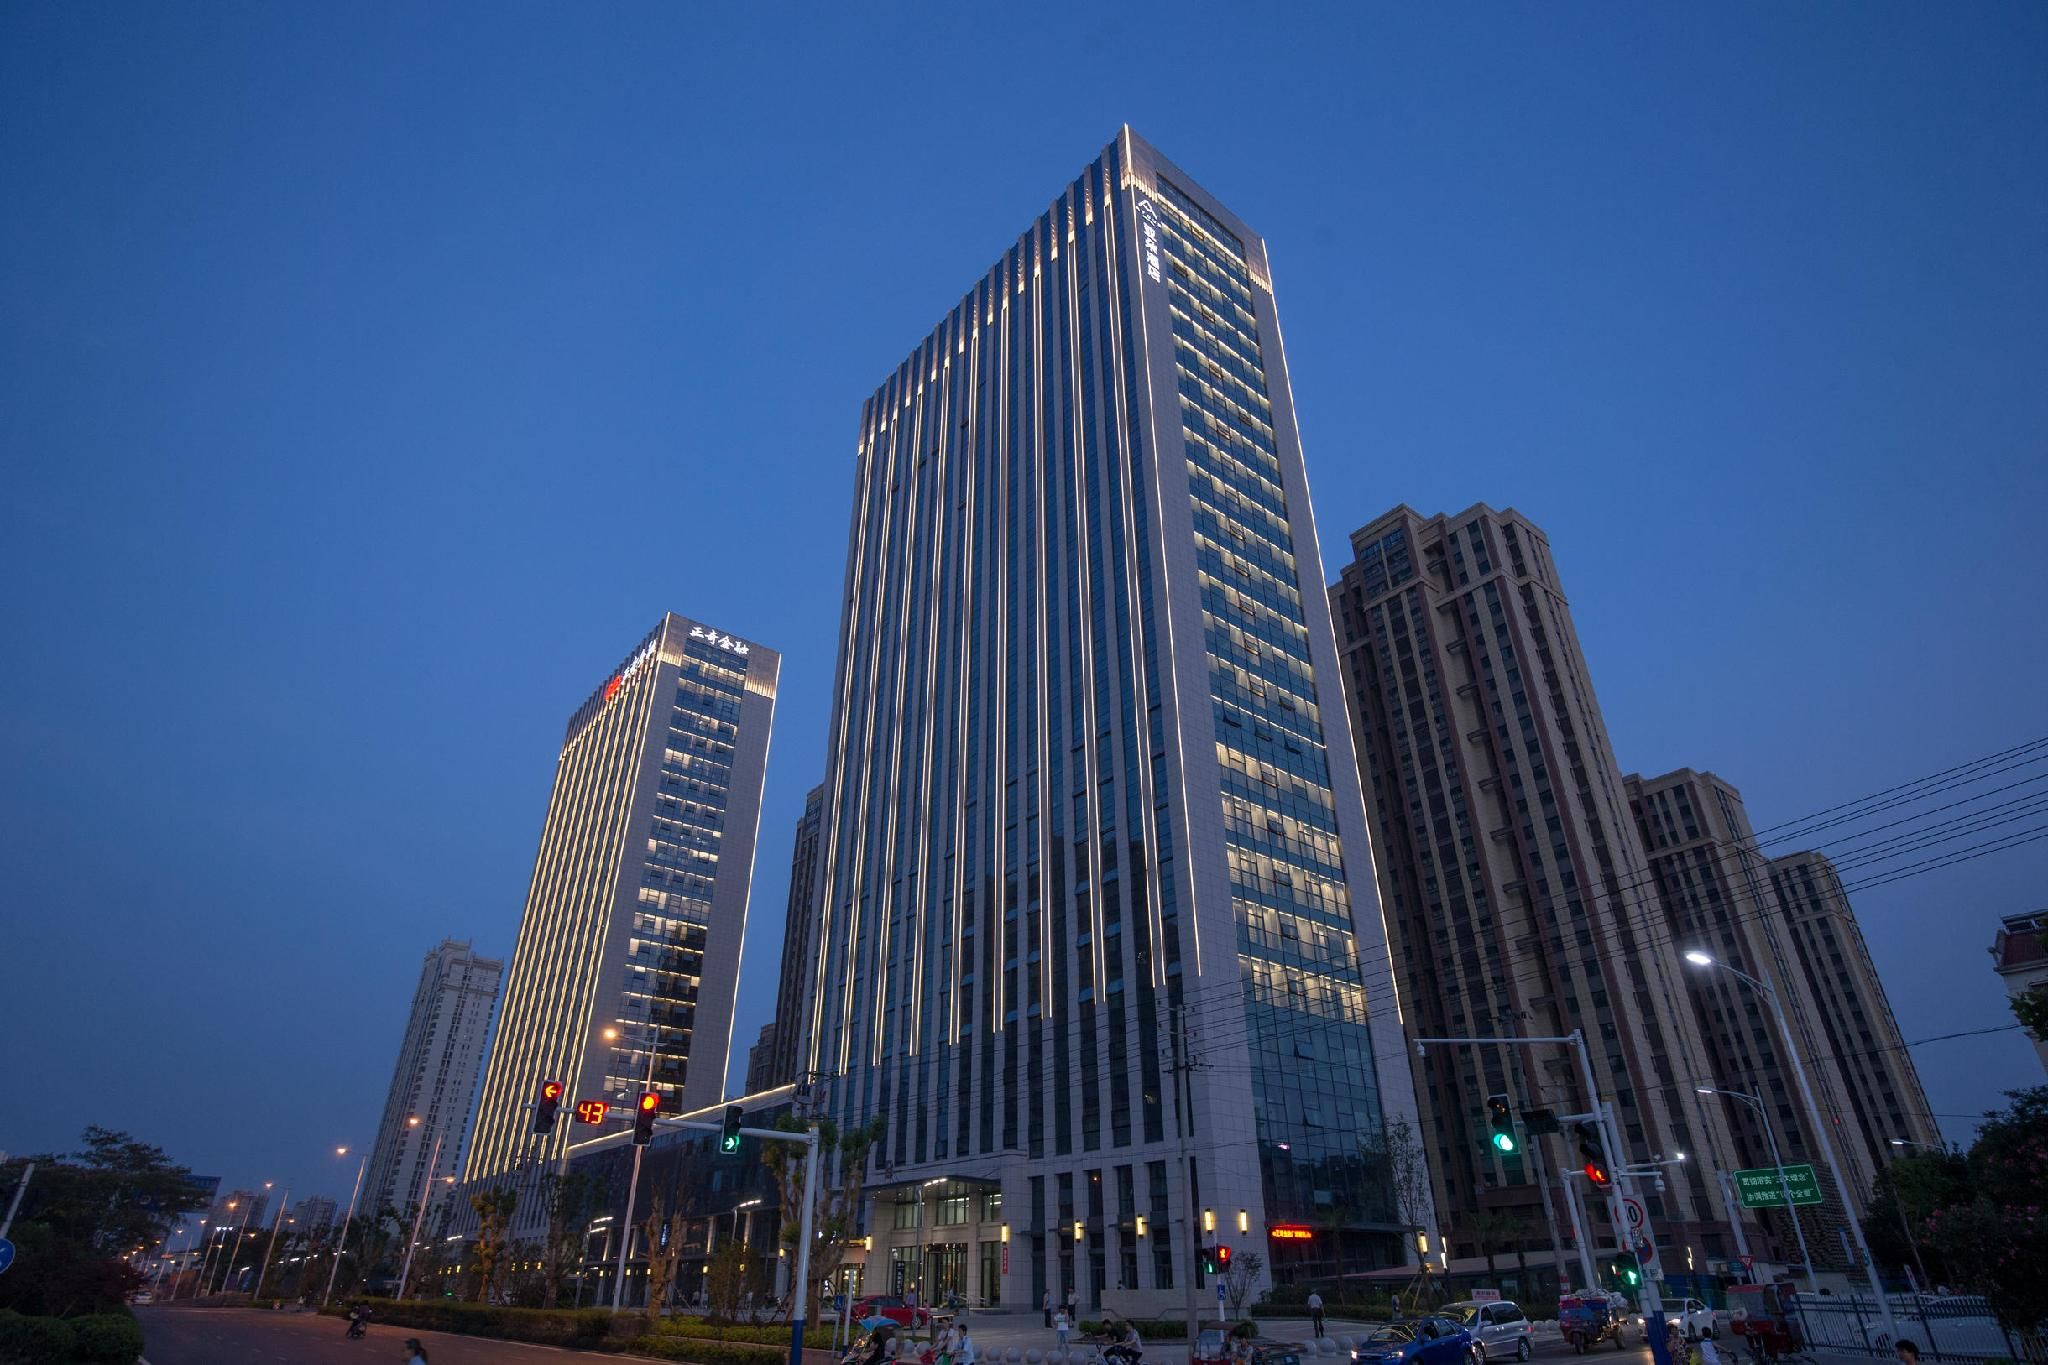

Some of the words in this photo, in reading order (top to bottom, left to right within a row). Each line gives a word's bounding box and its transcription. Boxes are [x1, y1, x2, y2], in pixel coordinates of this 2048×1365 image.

[689, 626, 750, 655] 正奇金融
[578, 1103, 605, 1125] 43
